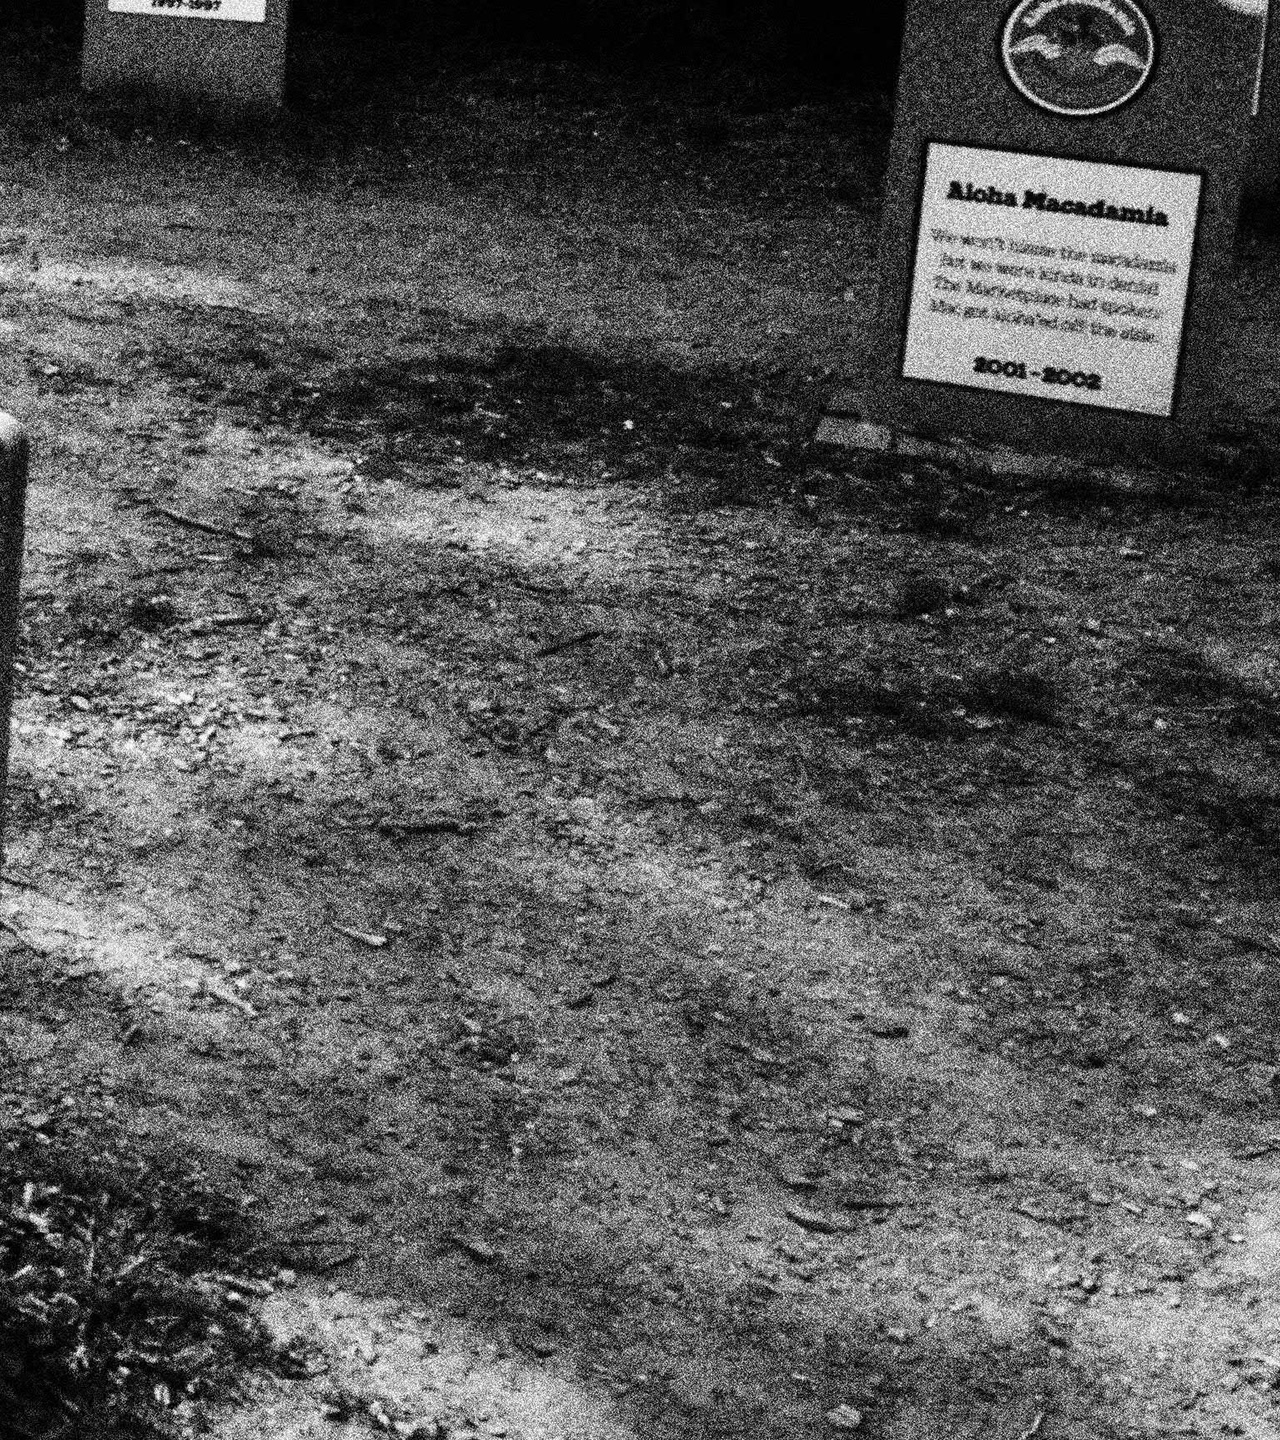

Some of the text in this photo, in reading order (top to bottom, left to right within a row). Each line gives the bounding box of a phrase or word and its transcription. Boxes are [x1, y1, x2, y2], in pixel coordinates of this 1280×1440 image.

[946, 180, 1169, 227] Aloha Macadamia
[972, 356, 1026, 379] 2001
[1041, 366, 1101, 390] 2002
